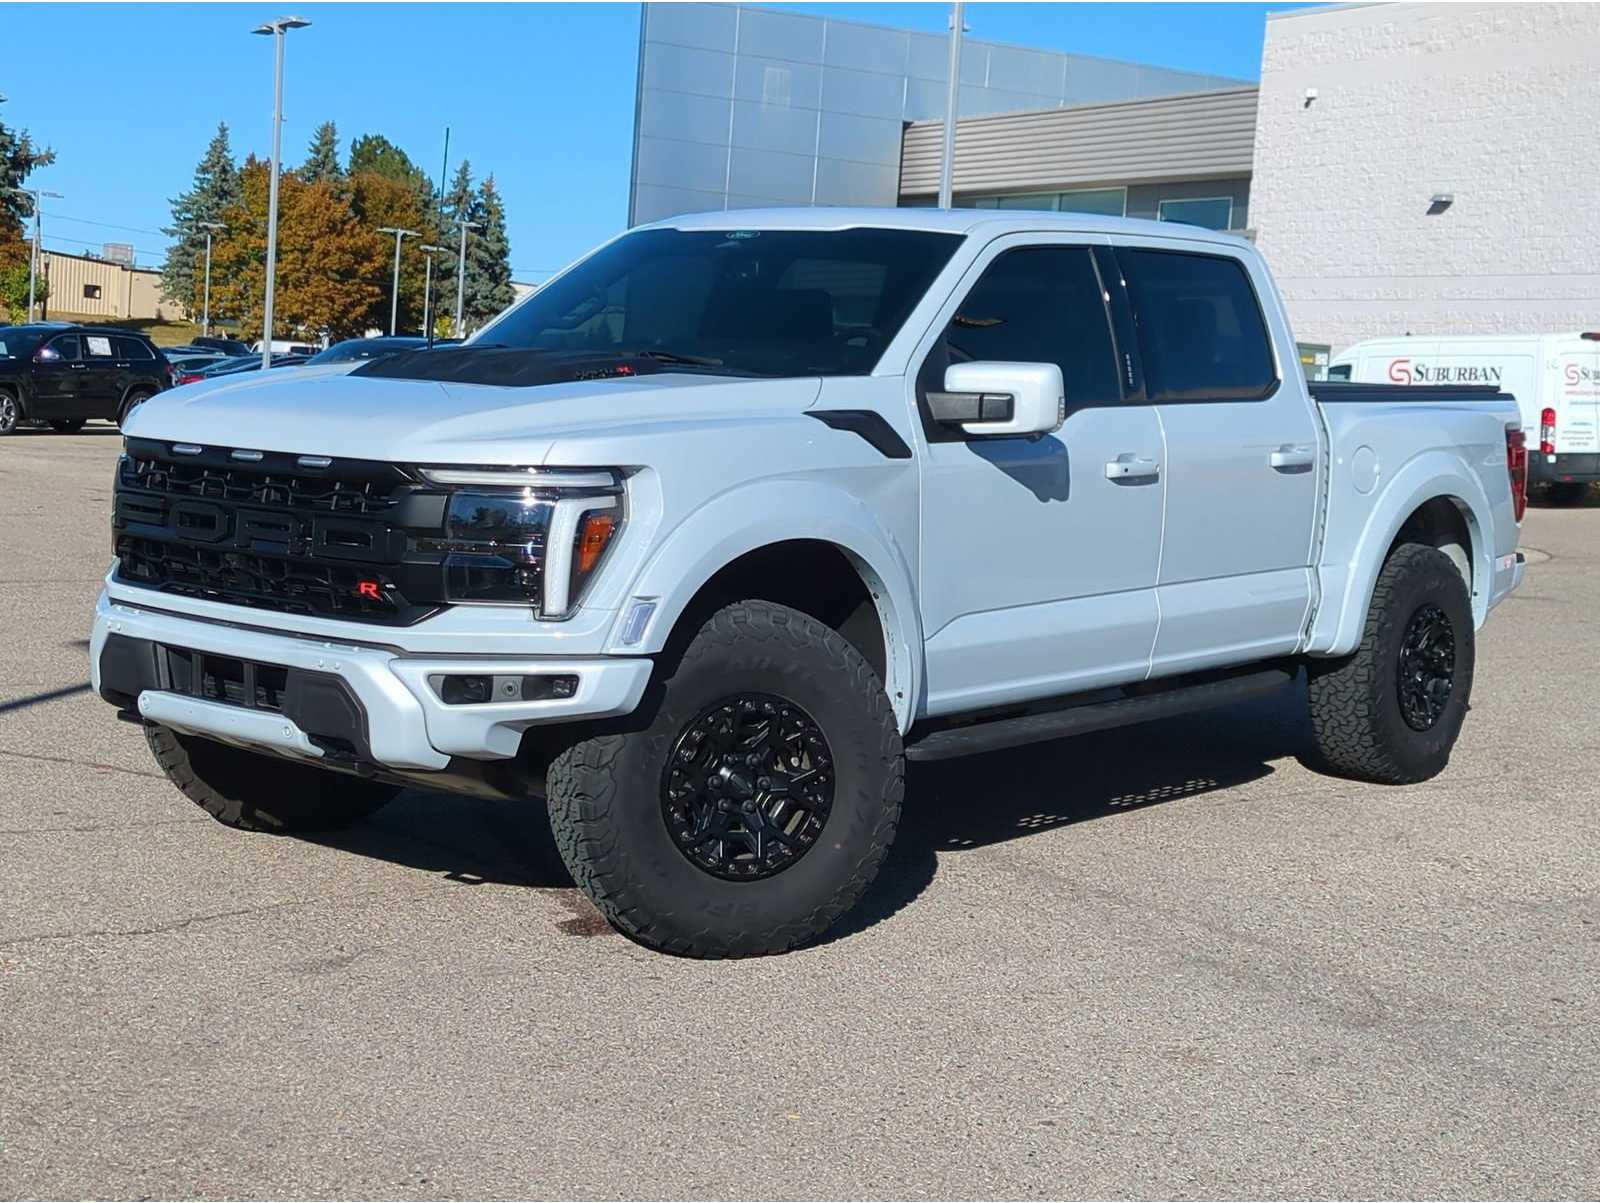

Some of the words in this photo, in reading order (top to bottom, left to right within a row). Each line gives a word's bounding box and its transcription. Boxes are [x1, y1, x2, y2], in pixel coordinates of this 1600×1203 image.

[1413, 363, 1502, 382] SUBURBAN
[116, 492, 389, 564] FORD
[358, 581, 381, 599] R
